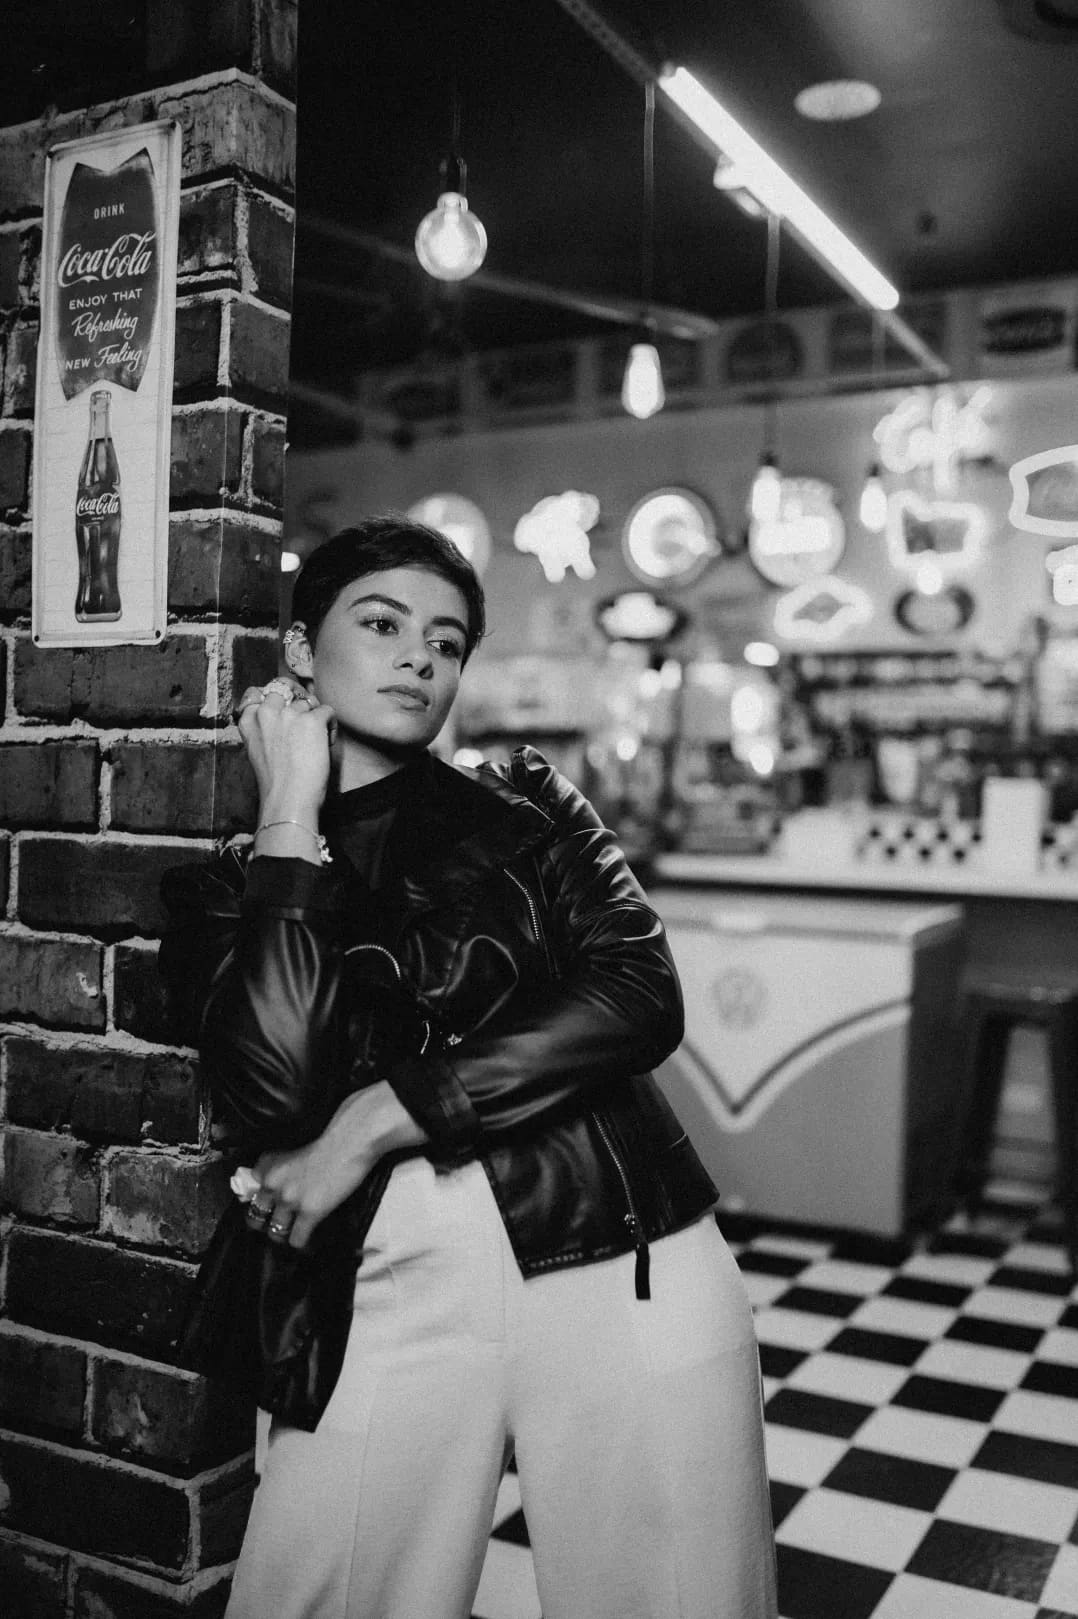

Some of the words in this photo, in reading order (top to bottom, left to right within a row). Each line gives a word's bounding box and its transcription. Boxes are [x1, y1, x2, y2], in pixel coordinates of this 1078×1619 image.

[93, 203, 125, 219] DRINK
[58, 231, 156, 288] Coca-Cola
[69, 296, 107, 310] ENJOY
[112, 288, 143, 302] THAT
[72, 309, 138, 343] Refreshing
[65, 357, 91, 370] NEW
[95, 342, 143, 371] Feeling
